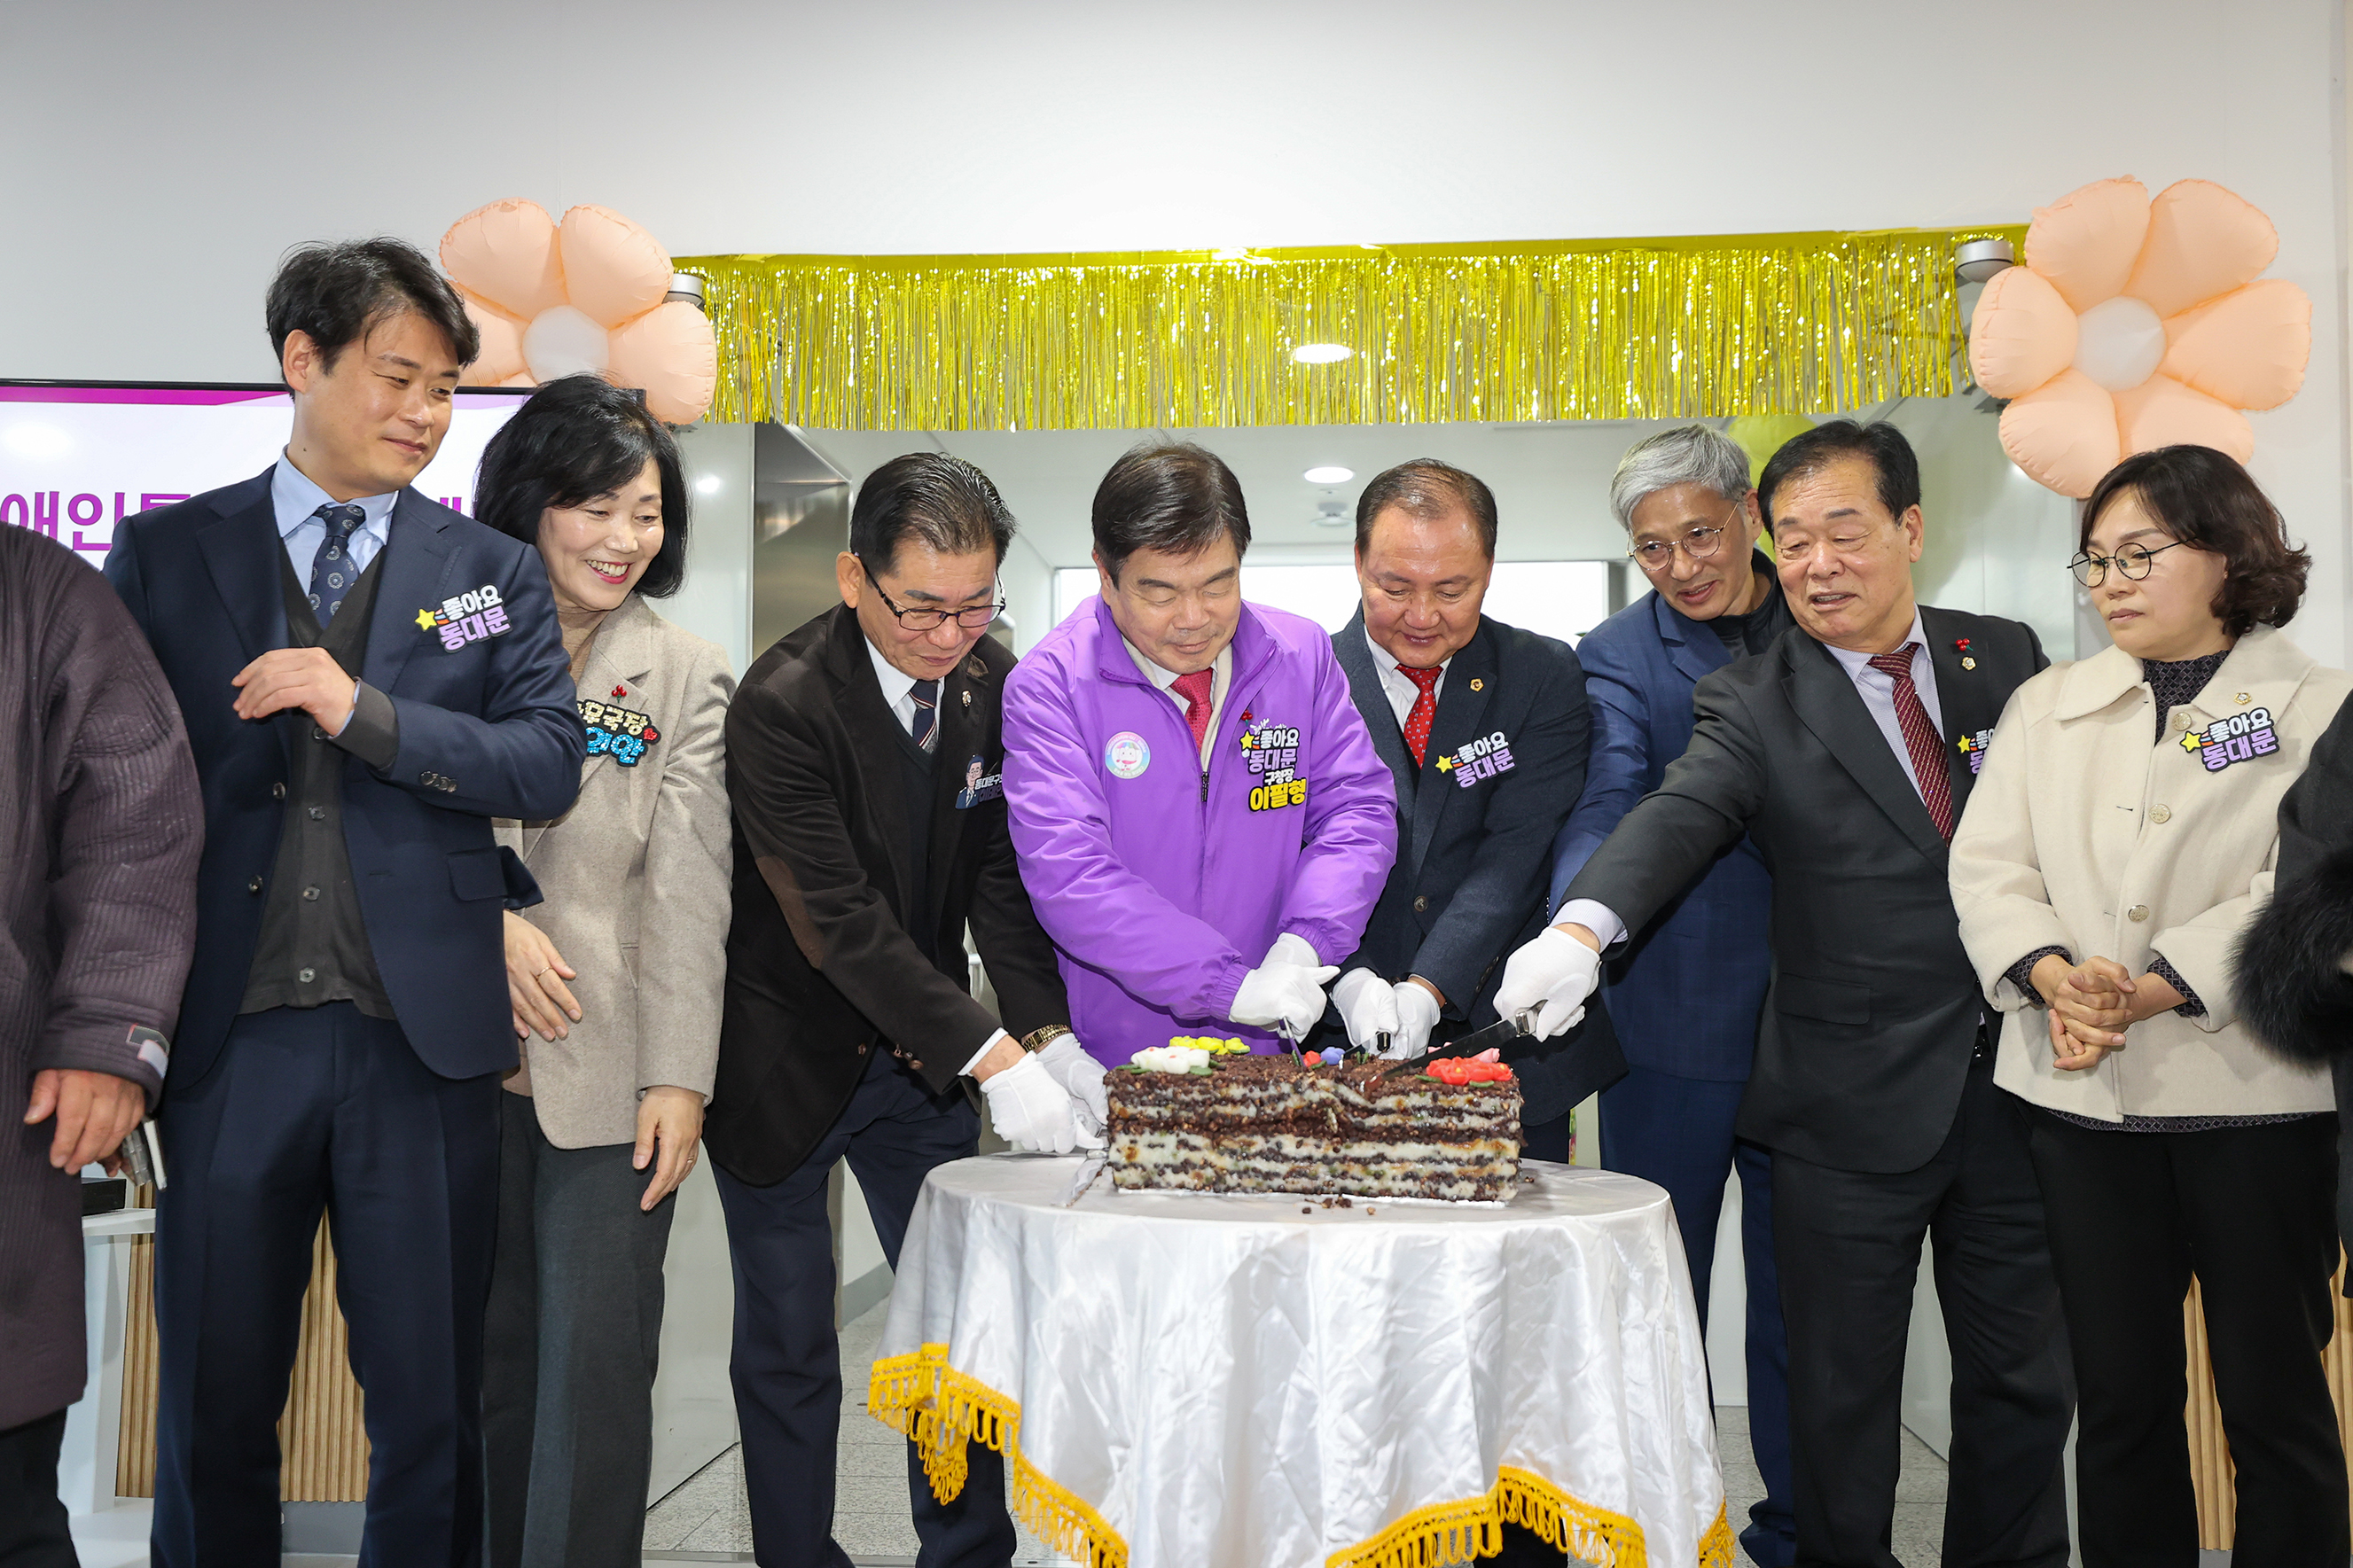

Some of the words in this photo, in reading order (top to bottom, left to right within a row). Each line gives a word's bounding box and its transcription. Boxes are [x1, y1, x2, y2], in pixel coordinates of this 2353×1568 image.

[0, 491, 191, 551] 애인
[442, 585, 503, 620] 좋아요
[438, 605, 511, 651] 동대문
[577, 701, 649, 736] 무국장
[2208, 709, 2271, 743] 좋아요
[1260, 728, 1299, 749] 좋아요
[1458, 731, 1509, 763] 좋아요
[2202, 728, 2277, 769] 동대문
[1248, 748, 1297, 773] 동대문
[1264, 768, 1295, 785] 구청장
[1454, 747, 1515, 788] 동대문
[1249, 778, 1307, 811] 이필형
